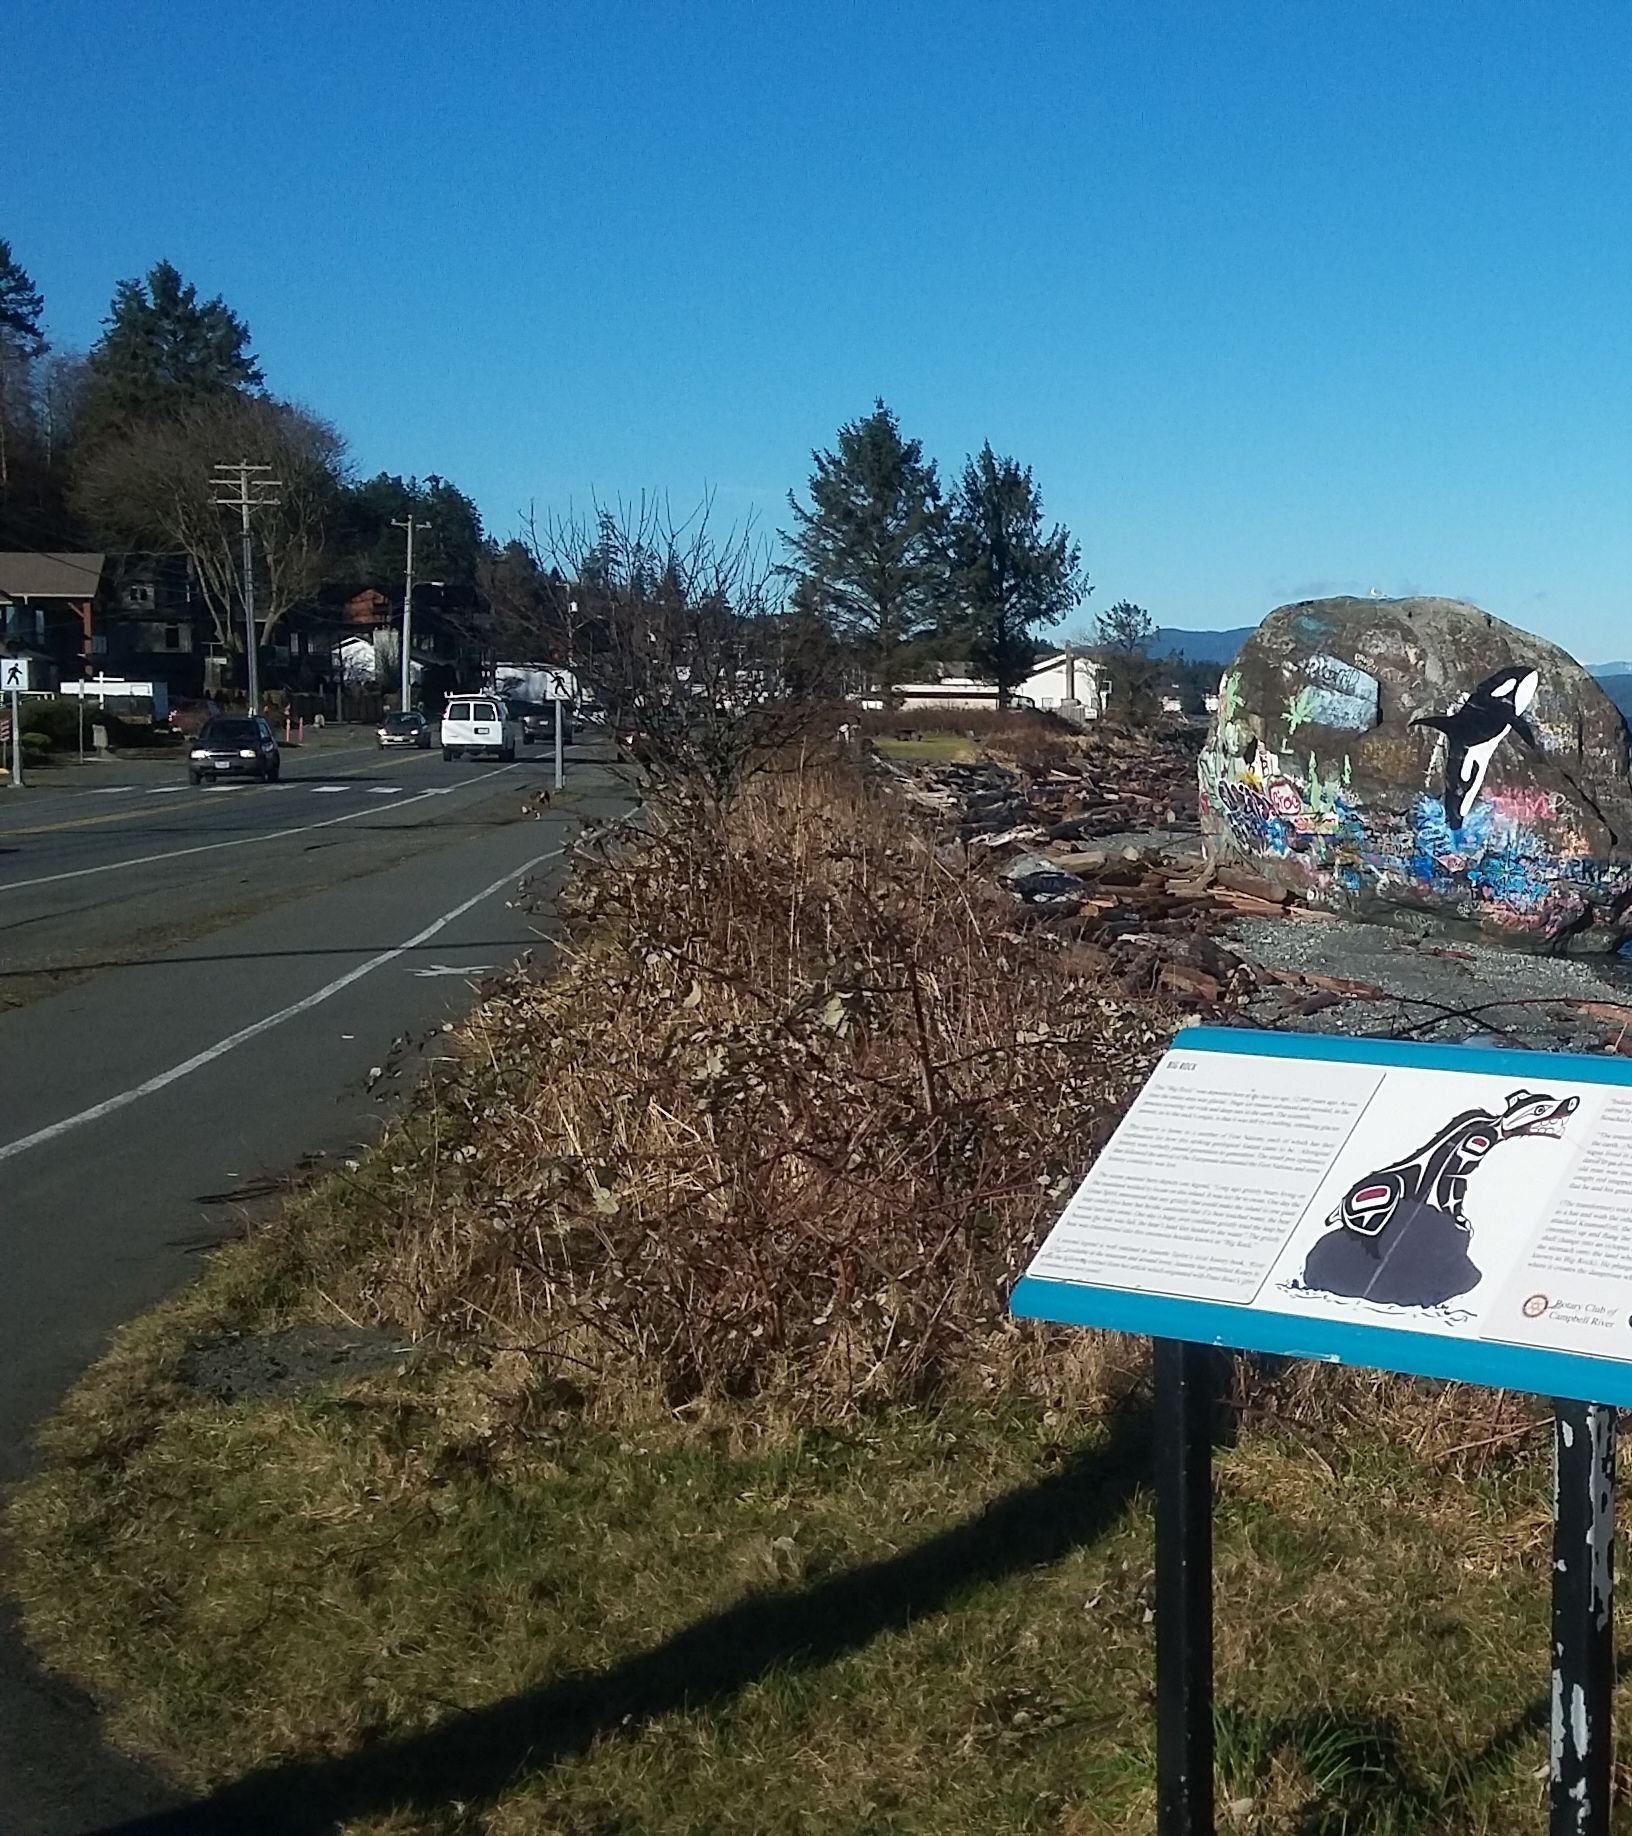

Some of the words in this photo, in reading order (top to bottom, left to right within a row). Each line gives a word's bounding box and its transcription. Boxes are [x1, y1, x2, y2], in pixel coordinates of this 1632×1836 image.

[1166, 1061, 1178, 1070] BIG
[1179, 1062, 1198, 1071] ROCK
[1554, 1299, 1583, 1313] Rotary
[1585, 1302, 1605, 1314] Club
[1607, 1306, 1619, 1316] of
[1548, 1311, 1589, 1326] Campbell
[1590, 1316, 1615, 1328] River
